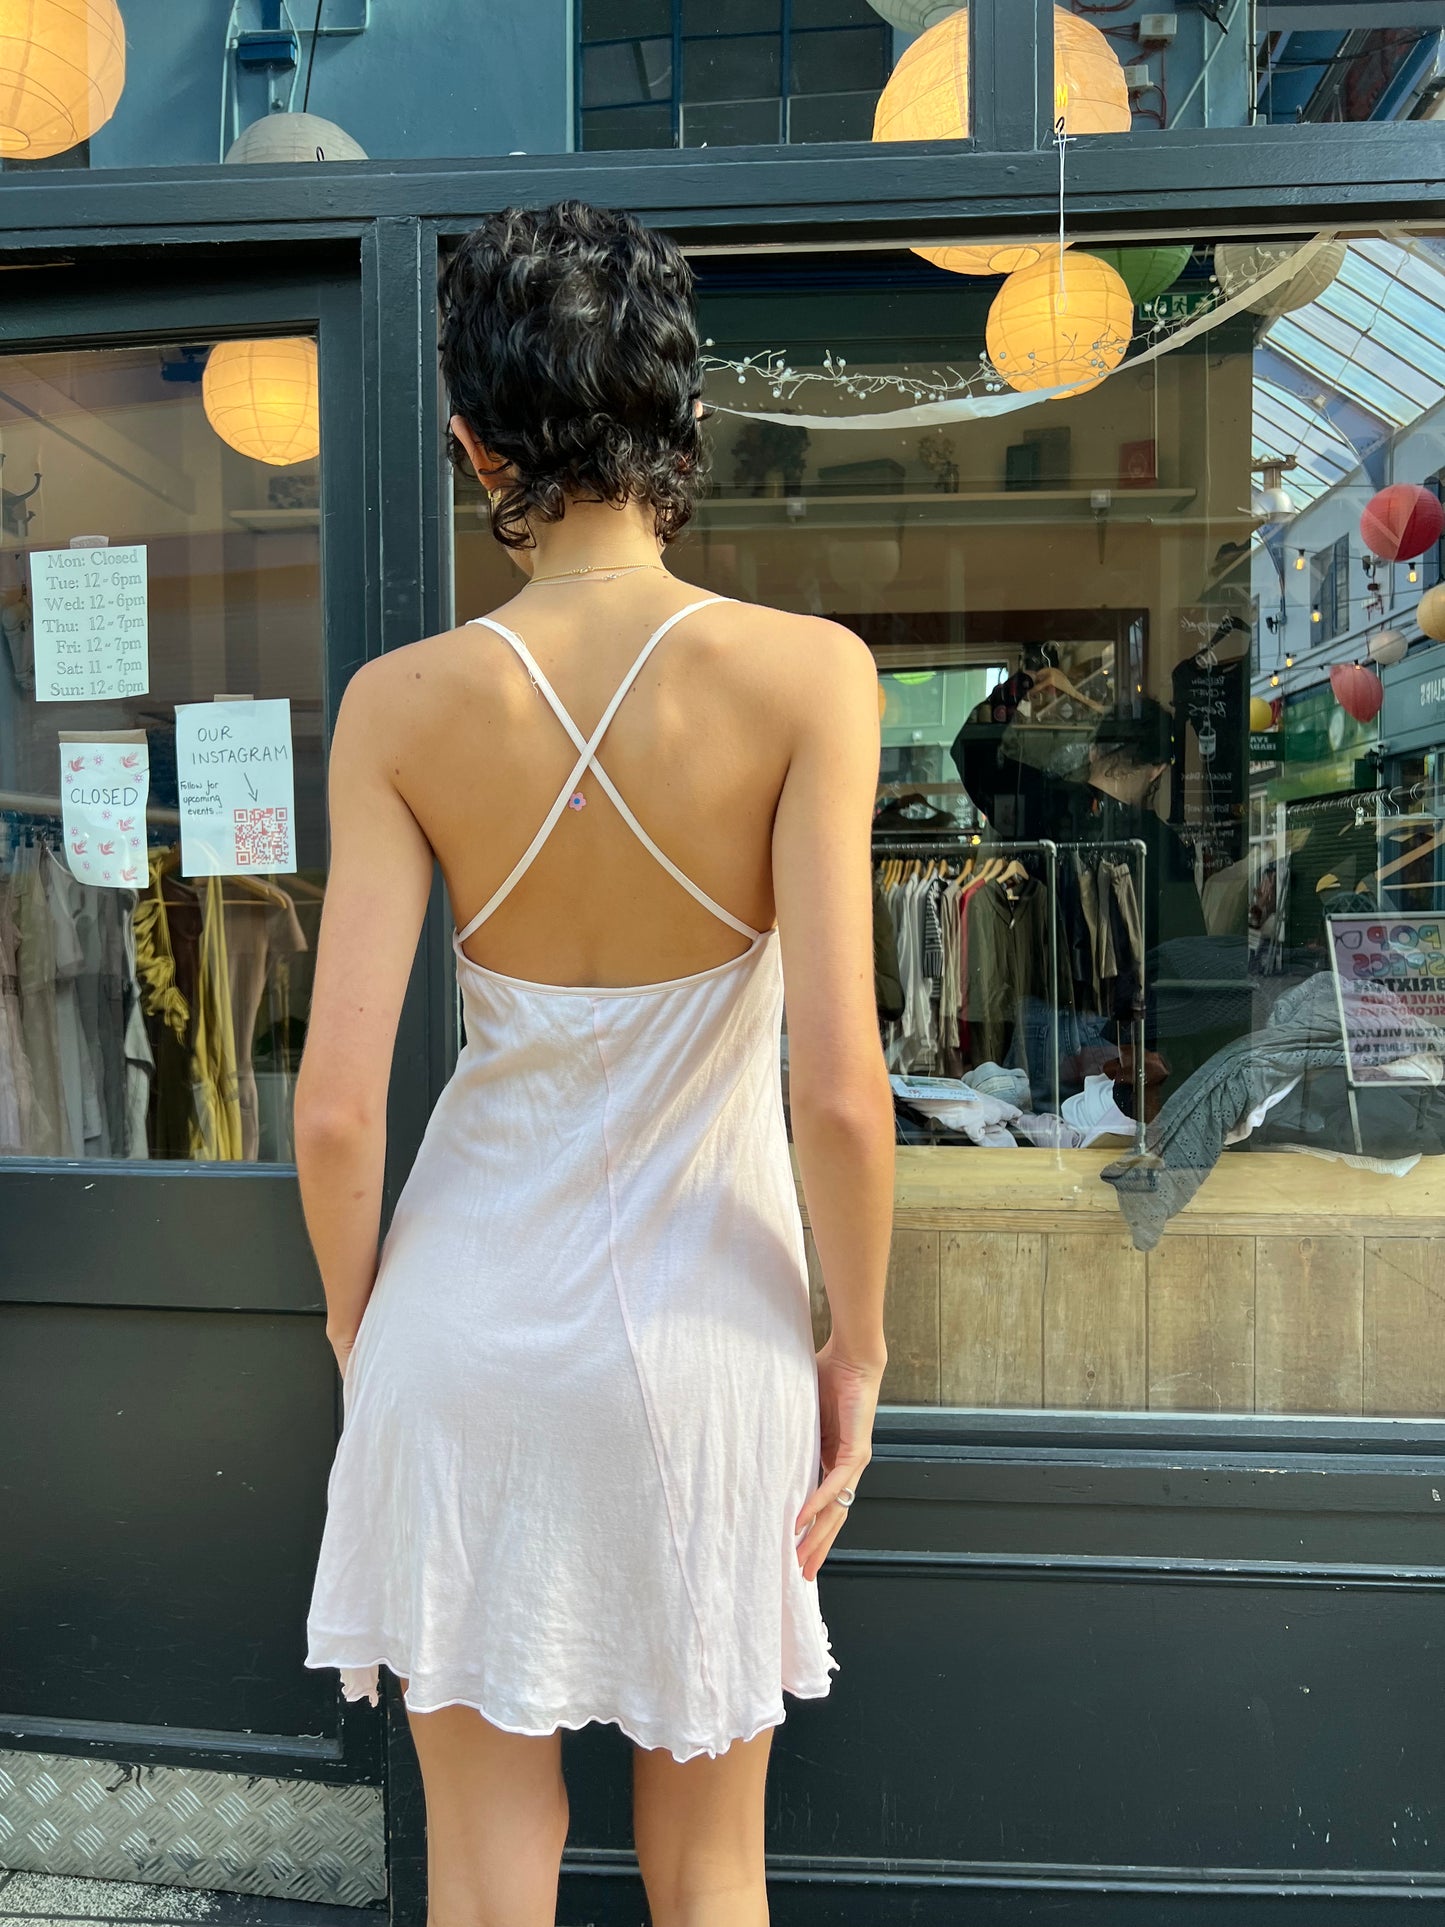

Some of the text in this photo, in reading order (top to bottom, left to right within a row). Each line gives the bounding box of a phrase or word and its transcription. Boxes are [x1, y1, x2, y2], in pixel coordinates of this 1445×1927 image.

[48, 549, 138, 568] Mon: Closed
[46, 576, 79, 590] Tue:
[84, 572, 101, 588] 12
[111, 572, 142, 589] 6pm
[44, 596, 84, 611] Wed:
[90, 594, 105, 609] 12
[116, 593, 145, 611] 6pm
[42, 619, 79, 632] Thu:
[89, 615, 105, 631] 12
[117, 614, 144, 632] 7pm
[56, 640, 81, 654] Fri:
[87, 637, 103, 652] 12
[115, 637, 141, 654] 7pm
[56, 661, 83, 675] Sat:
[89, 660, 102, 674] 11
[116, 658, 142, 675] 7pm
[50, 682, 84, 696] Sun:
[90, 679, 106, 695] 12
[117, 679, 144, 696] 6pm
[197, 725, 232, 742] OUR
[192, 745, 288, 765] INSTAGRAM
[180, 780, 218, 795] Follow for
[70, 787, 138, 806] CLOSED
[183, 795, 222, 808] upcoming
